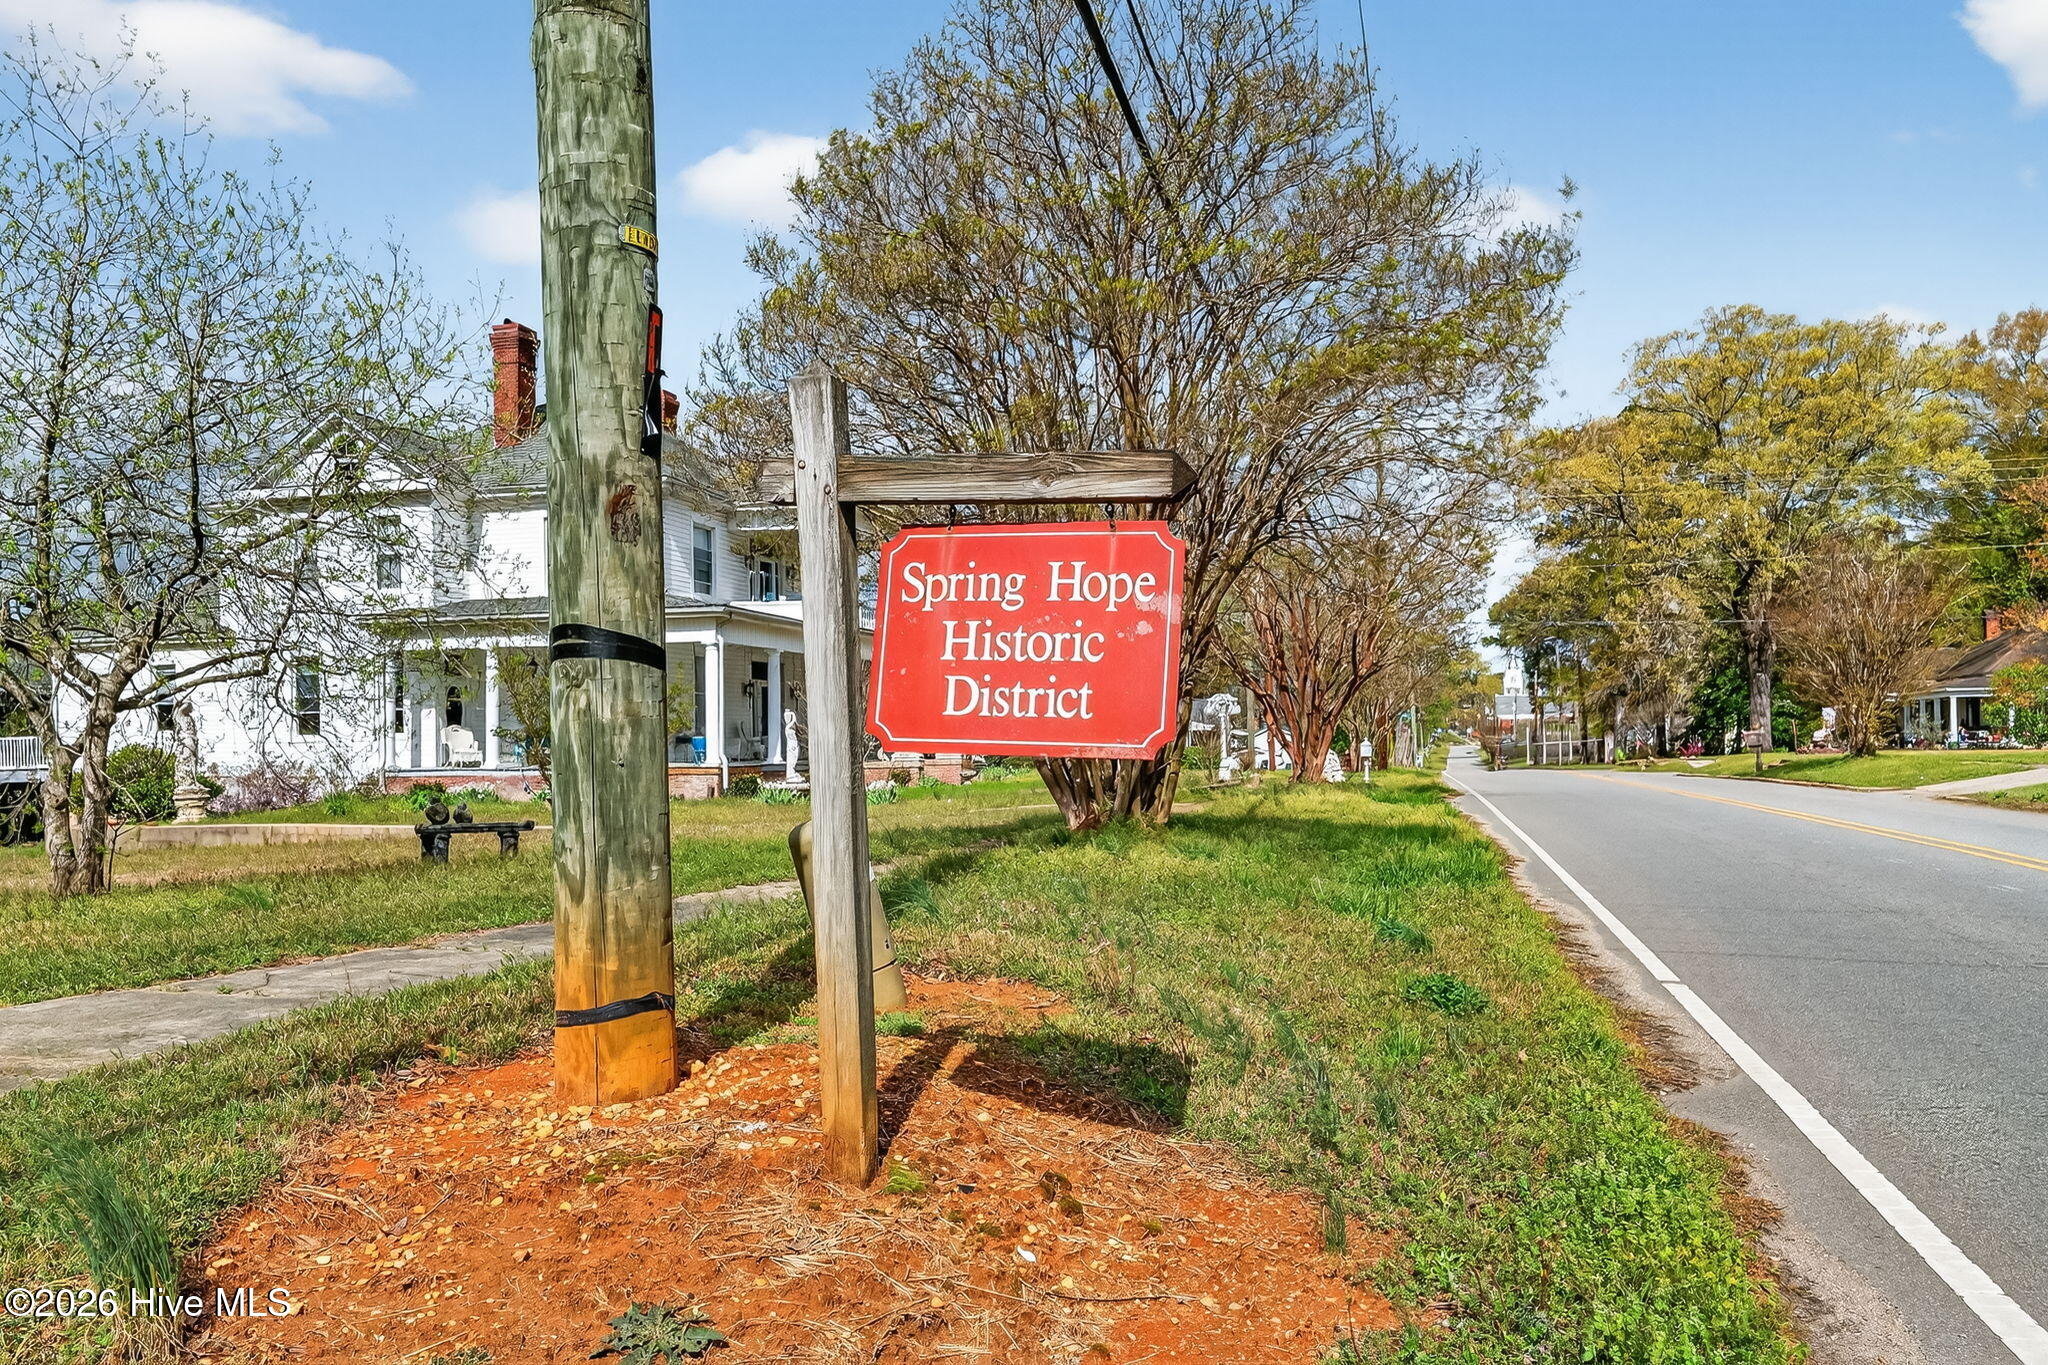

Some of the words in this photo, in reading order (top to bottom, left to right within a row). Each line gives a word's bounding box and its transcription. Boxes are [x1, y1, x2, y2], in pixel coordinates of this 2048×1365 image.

[901, 561, 1026, 612] Spring
[1046, 561, 1156, 612] Hope
[940, 620, 1105, 663] Historic
[942, 675, 1093, 719] District
